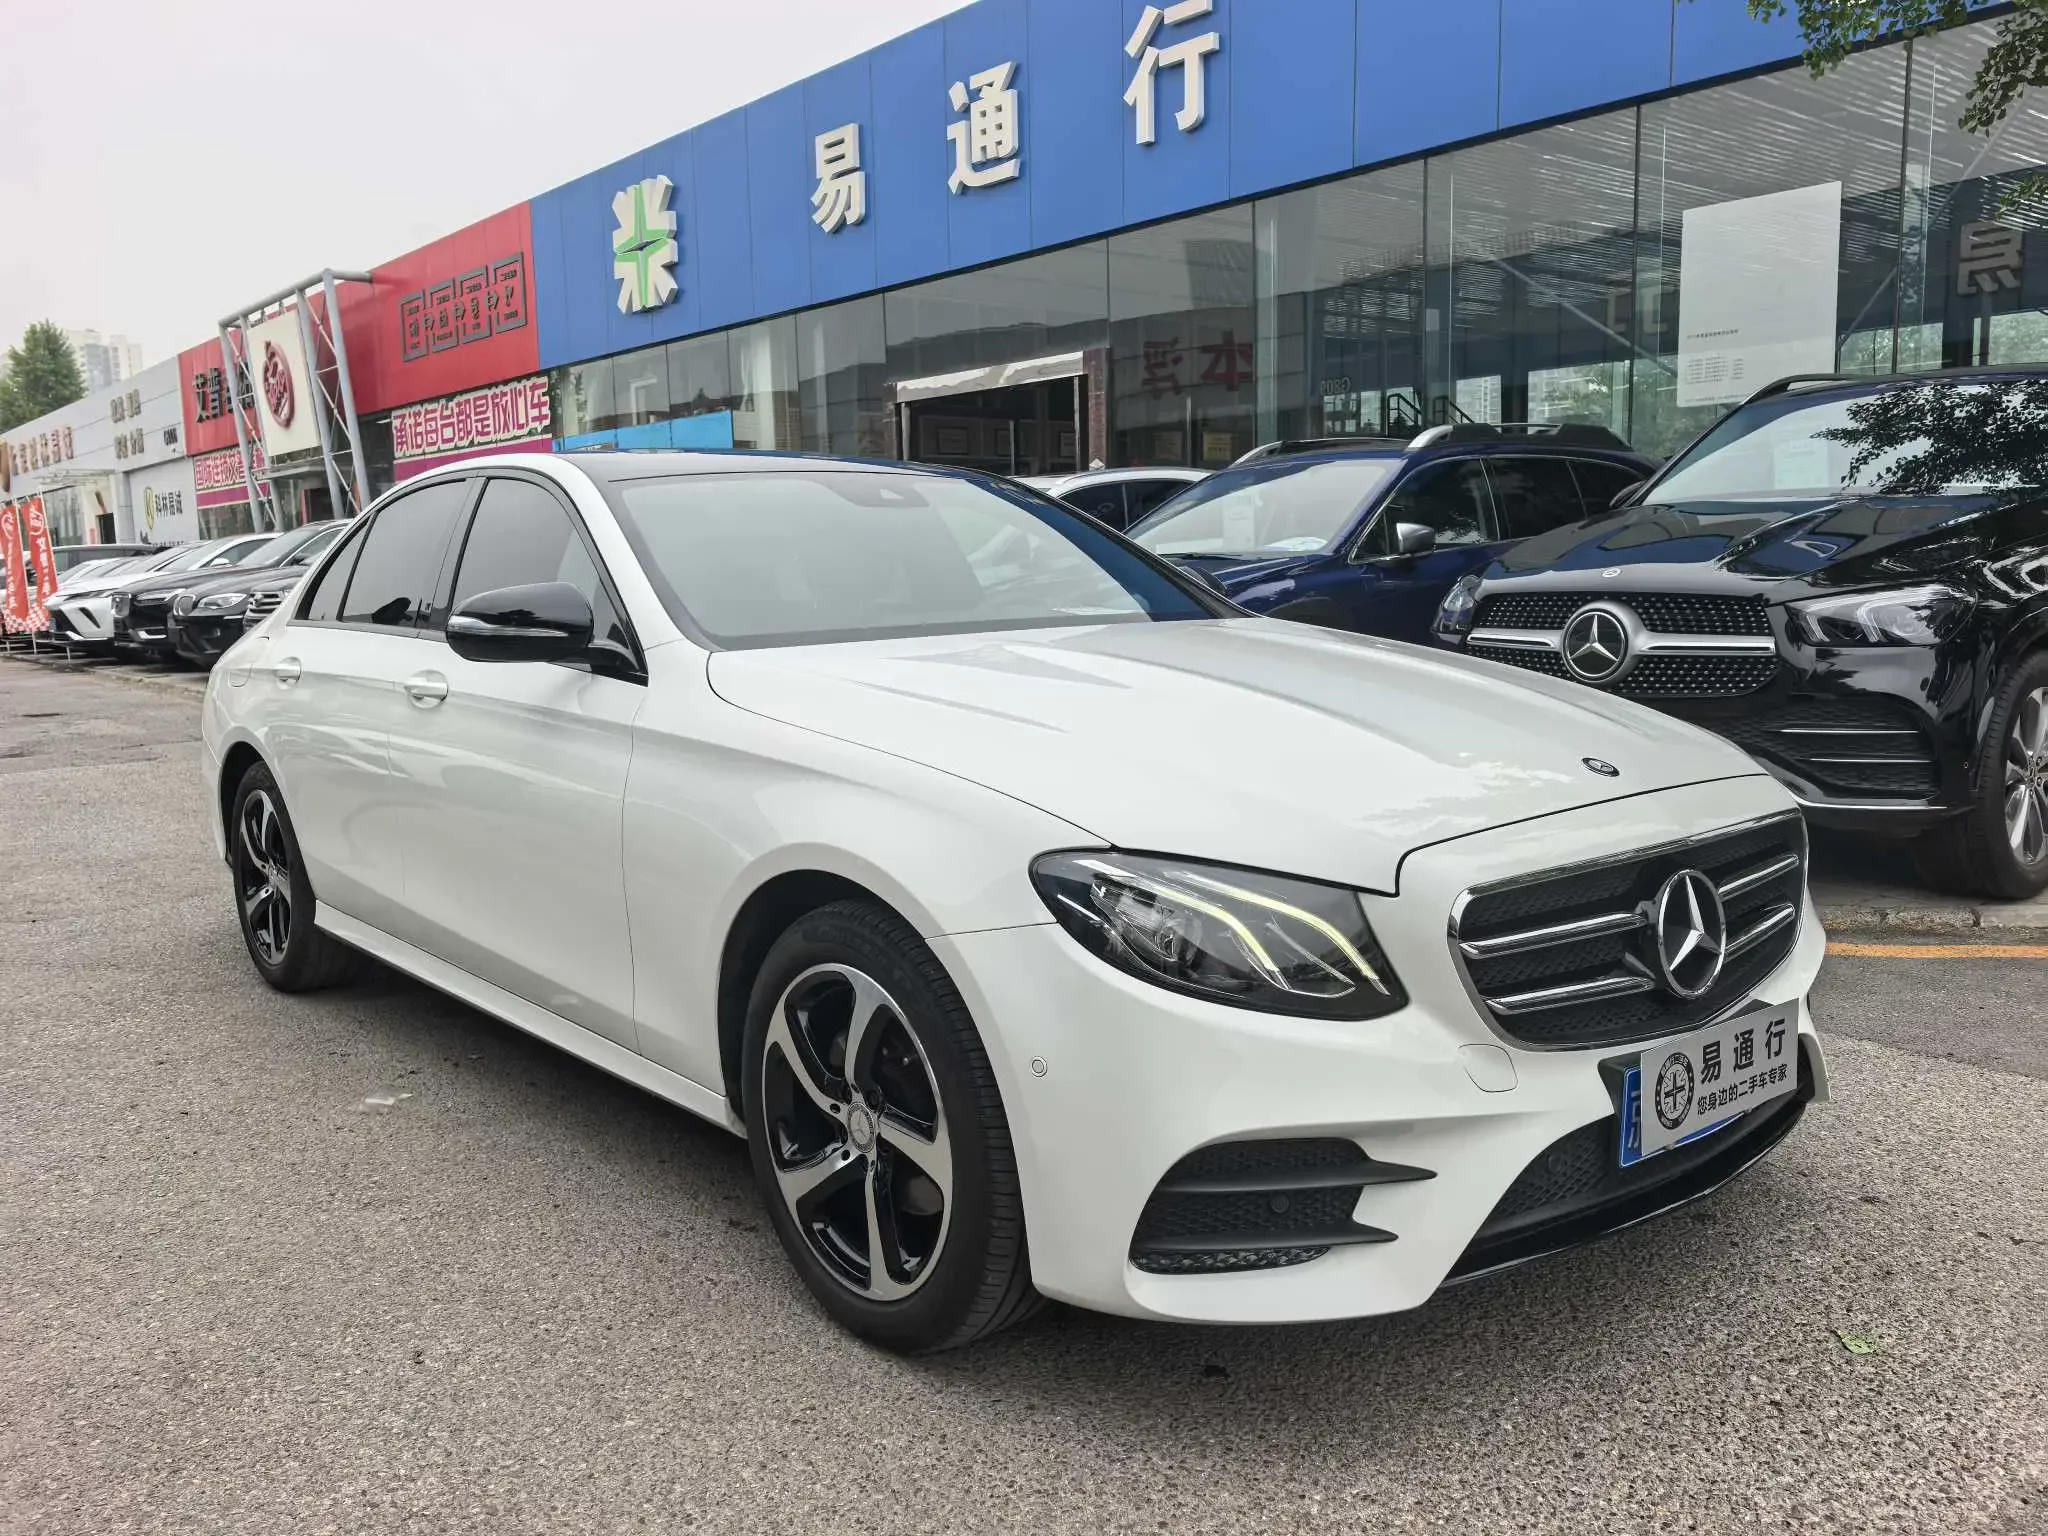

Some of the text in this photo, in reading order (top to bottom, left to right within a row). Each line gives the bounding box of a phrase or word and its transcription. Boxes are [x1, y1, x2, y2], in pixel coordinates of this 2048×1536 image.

[810, 0, 1220, 234] 易通行
[392, 379, 551, 455] 承诺每台都是放心车
[1700, 1018, 1786, 1085] 易通行
[1697, 1063, 1788, 1116] 您身边的二手车专家
